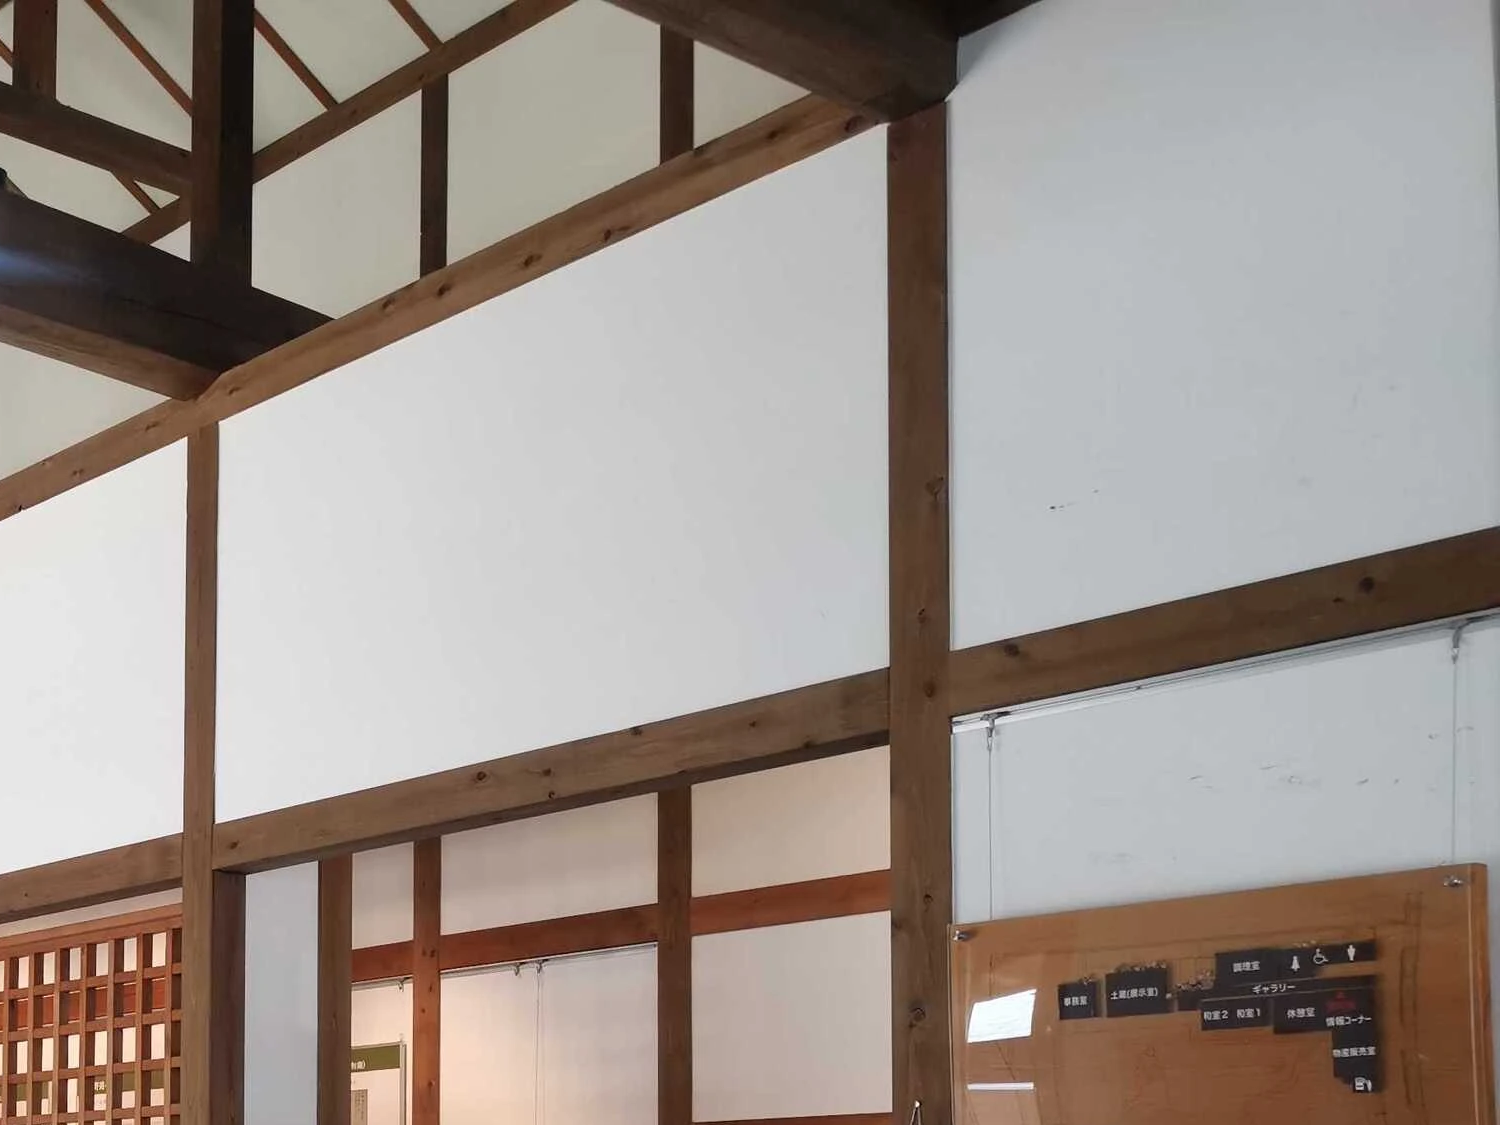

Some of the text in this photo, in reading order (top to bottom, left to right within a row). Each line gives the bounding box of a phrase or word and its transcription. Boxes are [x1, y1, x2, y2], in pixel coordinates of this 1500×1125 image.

[1252, 983, 1296, 994] ギャラリー
[1287, 1007, 1316, 1019] 休憩室
[1326, 1015, 1372, 1027] 情報コーナー
